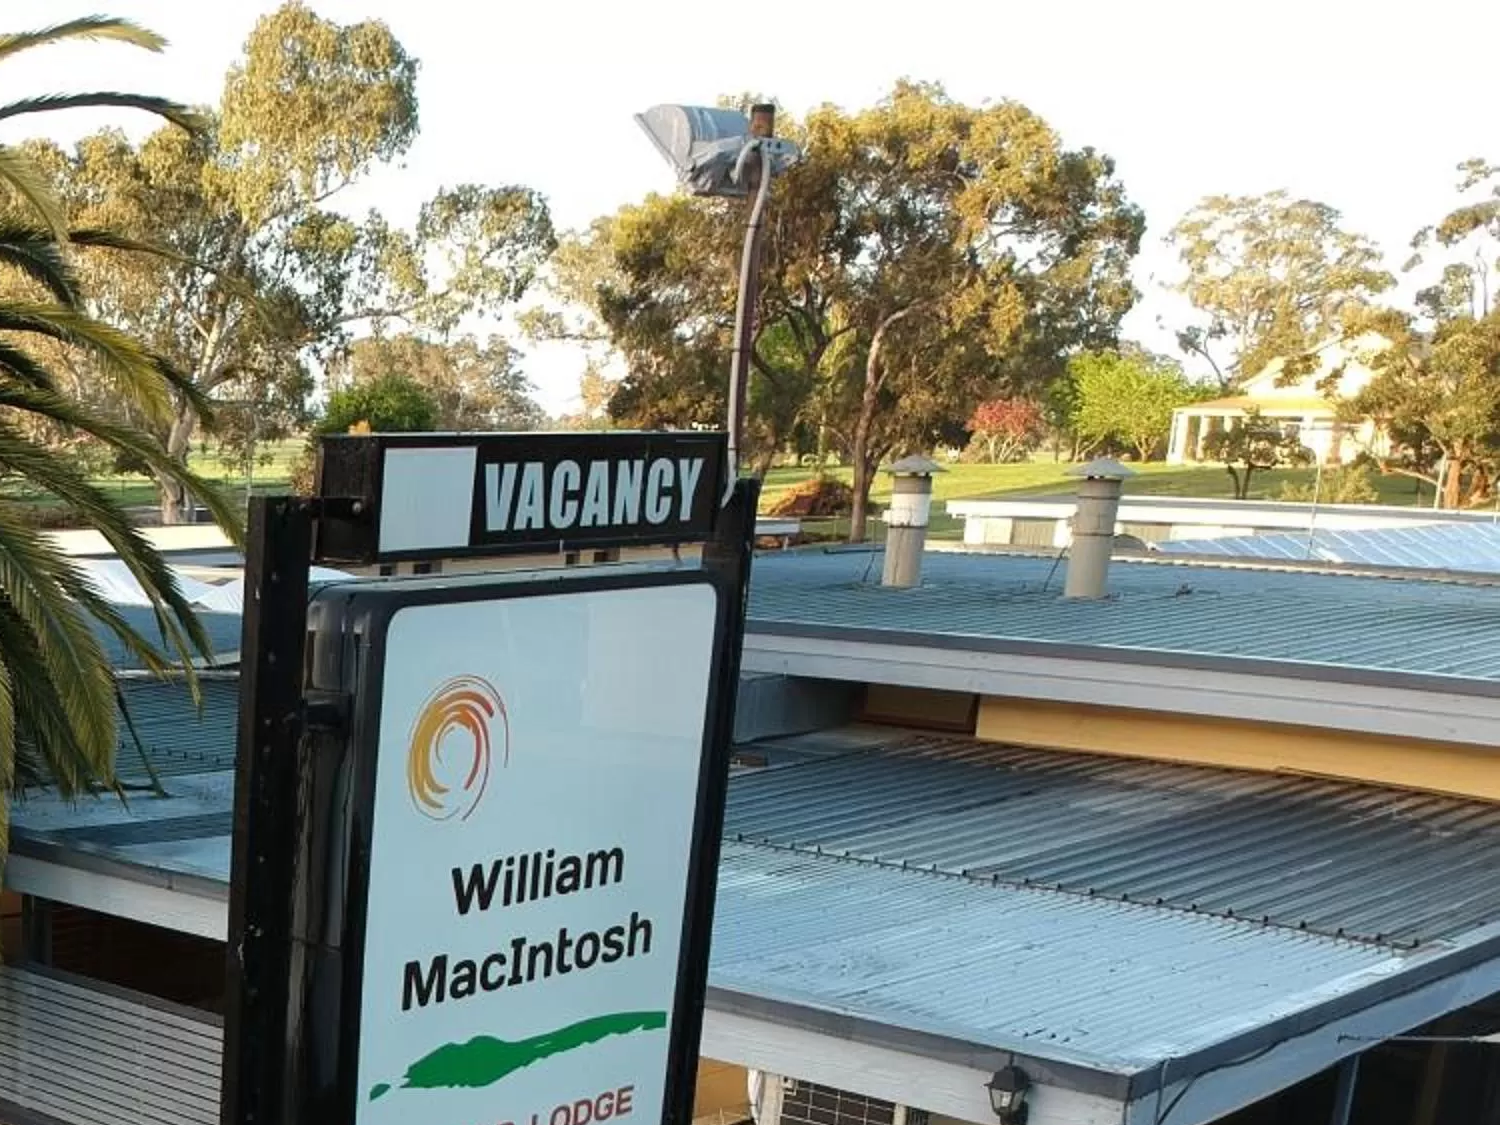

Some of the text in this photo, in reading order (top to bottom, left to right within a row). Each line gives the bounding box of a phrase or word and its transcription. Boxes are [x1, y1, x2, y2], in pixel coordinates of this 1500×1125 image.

[484, 457, 704, 533] VACANCY
[451, 847, 625, 915] William
[401, 911, 653, 1011] MacIntosh
